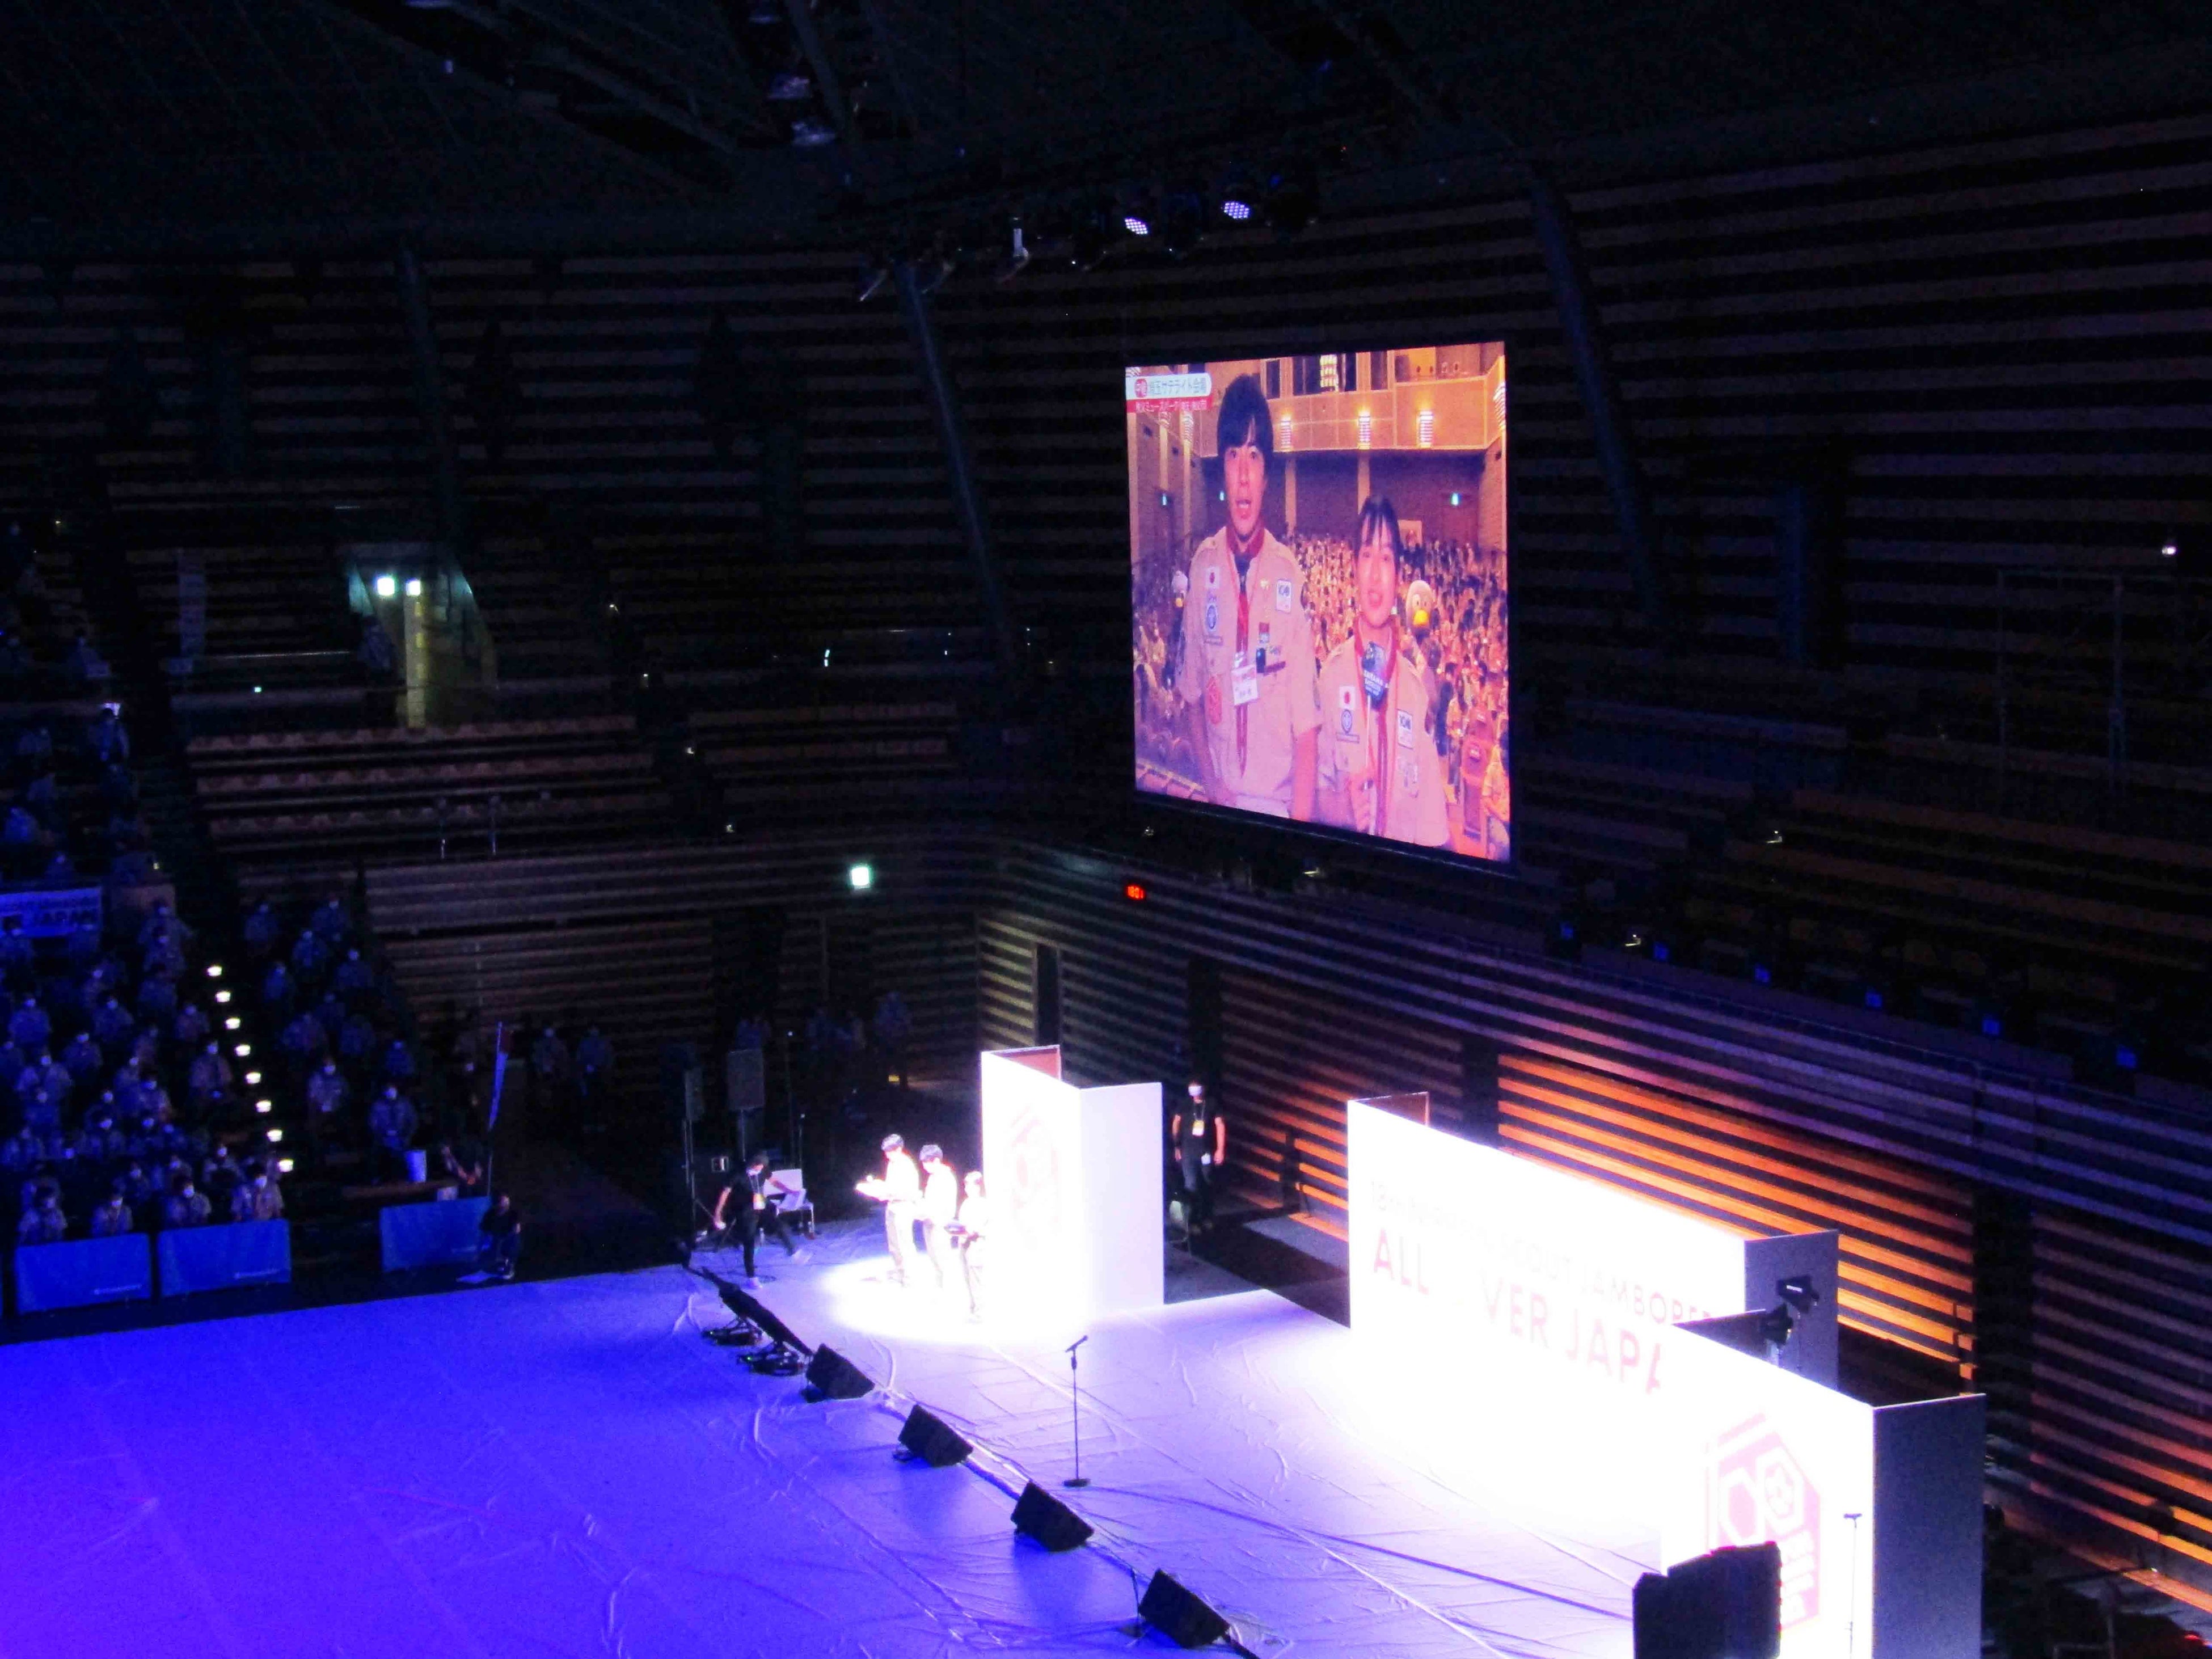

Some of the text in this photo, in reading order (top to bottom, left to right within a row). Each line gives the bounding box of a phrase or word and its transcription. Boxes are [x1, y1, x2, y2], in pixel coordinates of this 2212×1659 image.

[1373, 1227, 1430, 1297] ALL
[1479, 1268, 1549, 1350] VER
[1580, 1261, 1712, 1324] JAMBOR
